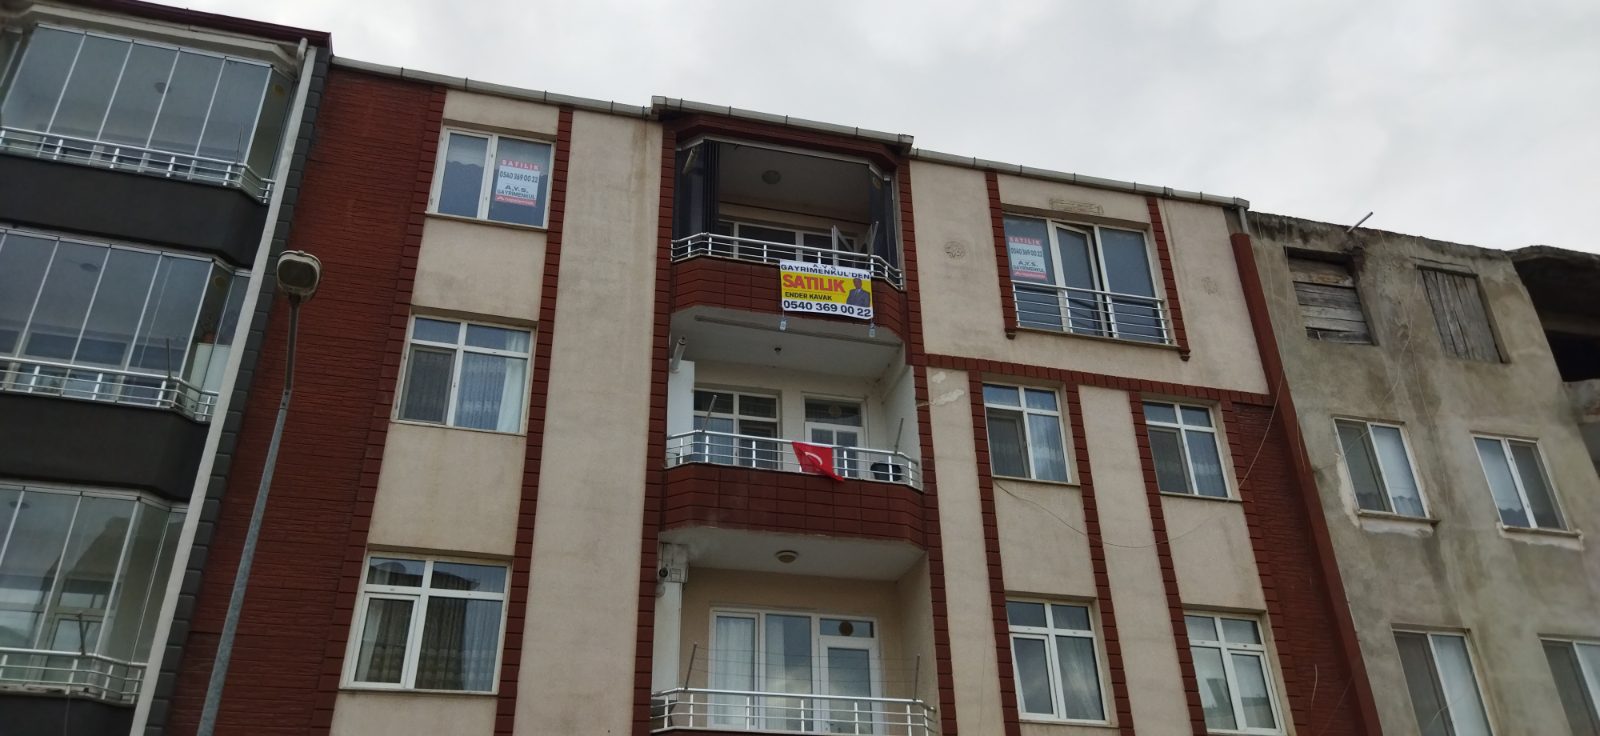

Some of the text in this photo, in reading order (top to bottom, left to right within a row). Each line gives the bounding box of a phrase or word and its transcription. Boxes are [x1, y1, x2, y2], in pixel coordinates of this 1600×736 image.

[502, 160, 540, 170] SATILIK
[783, 274, 846, 293] SATILIK
[784, 300, 872, 318] 0540 369 00 22
